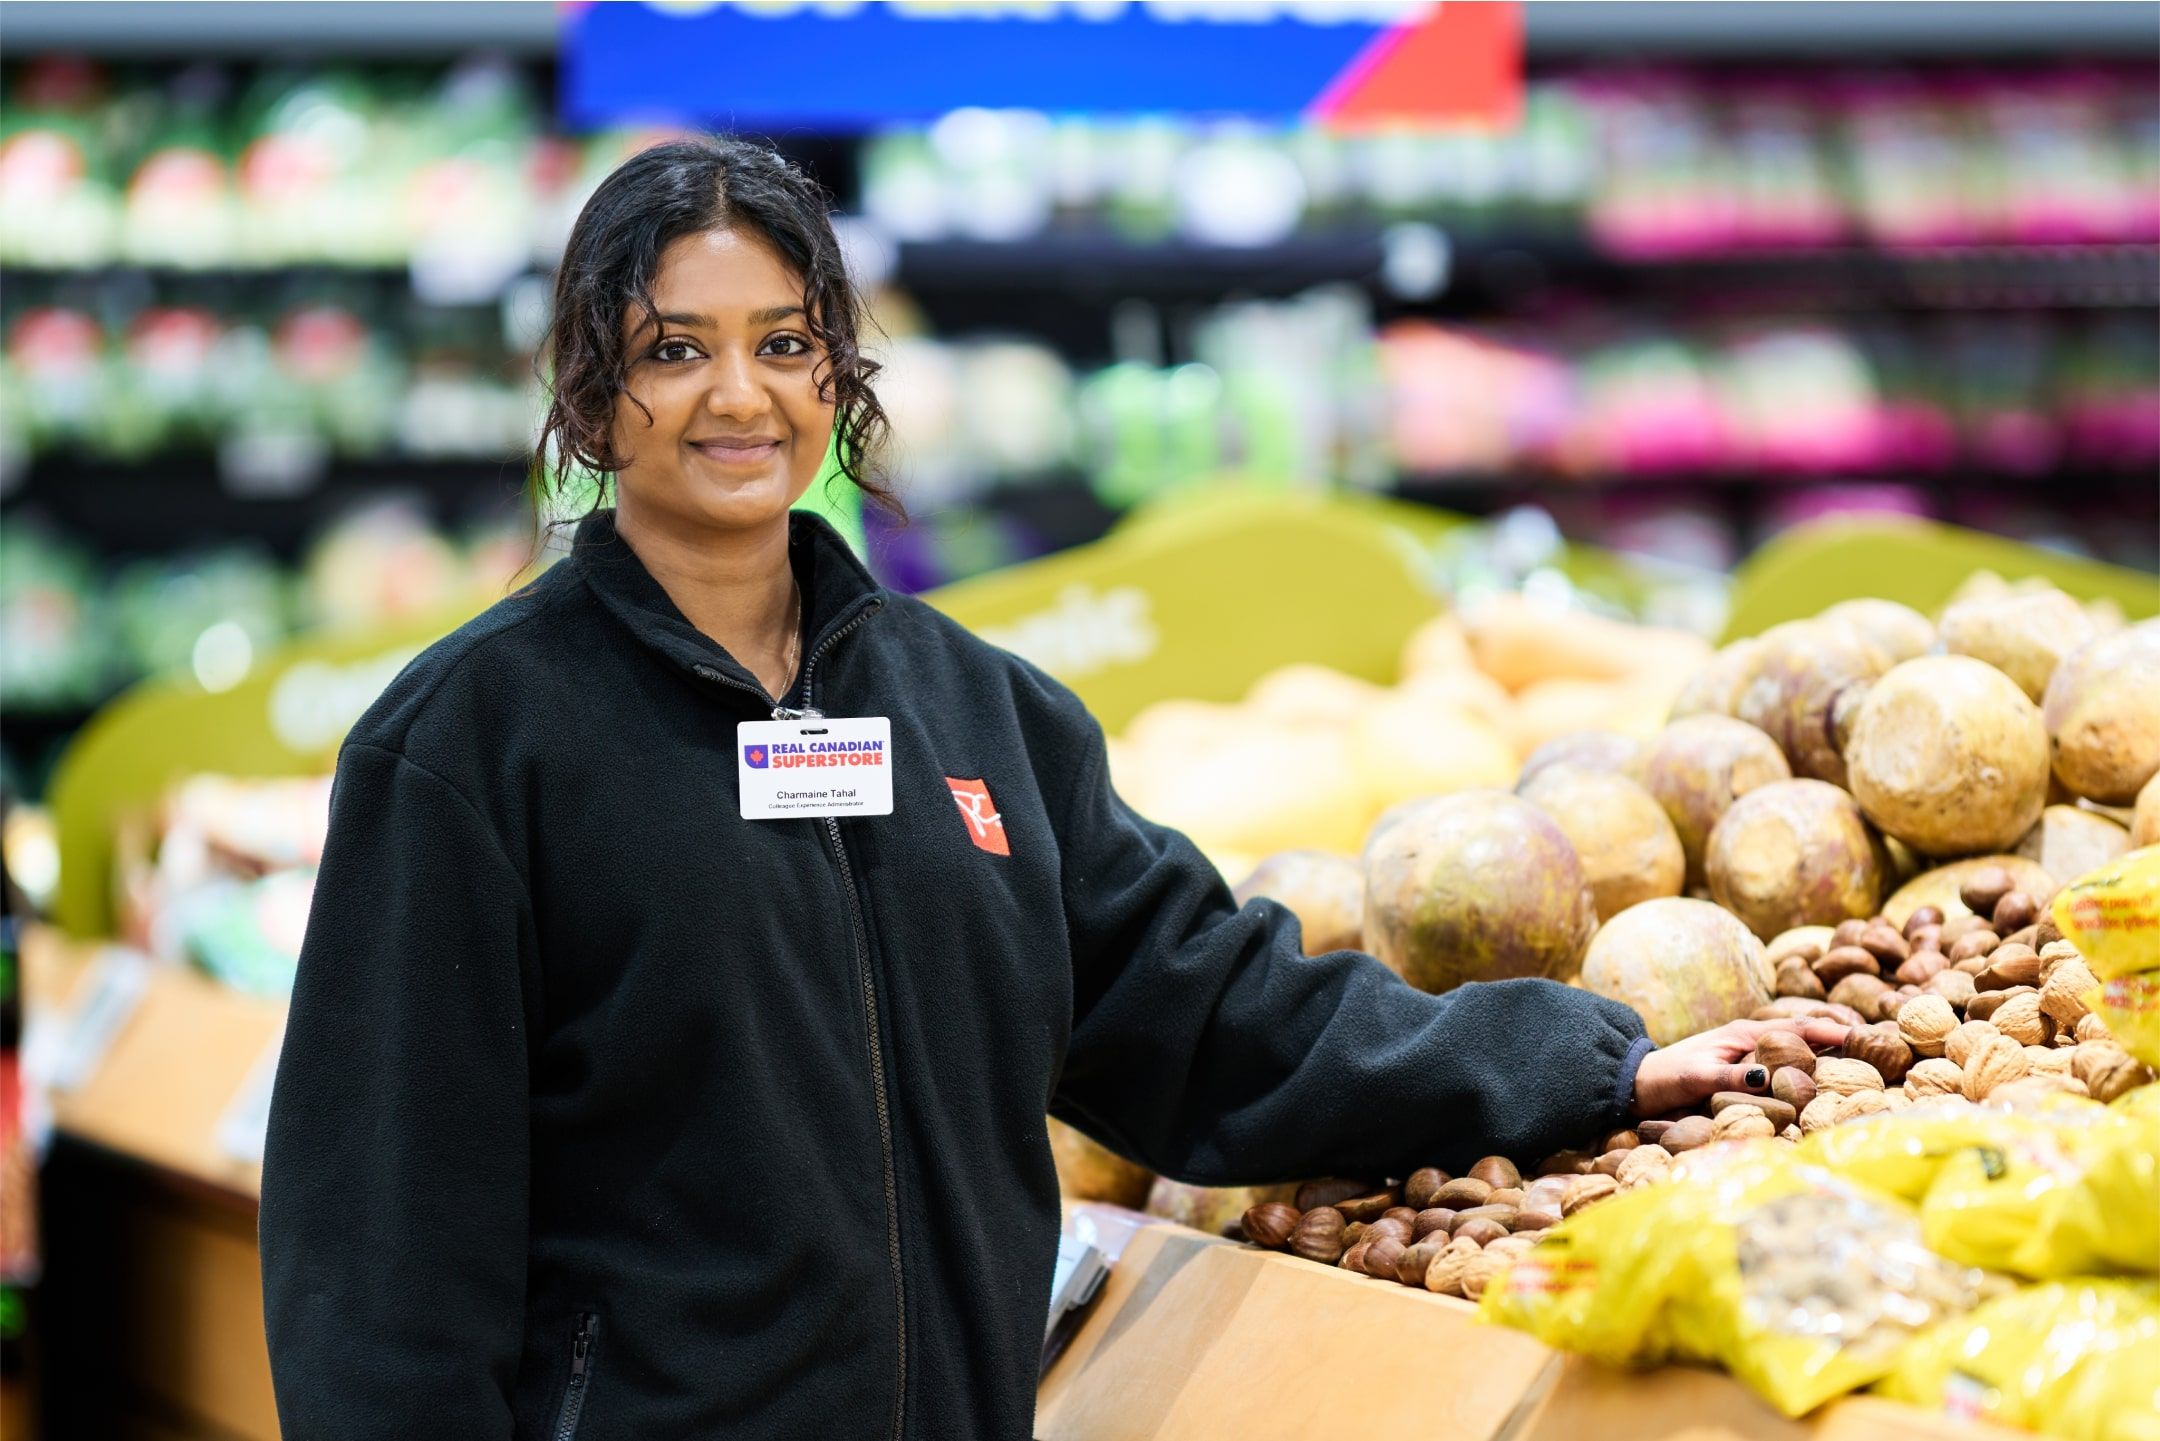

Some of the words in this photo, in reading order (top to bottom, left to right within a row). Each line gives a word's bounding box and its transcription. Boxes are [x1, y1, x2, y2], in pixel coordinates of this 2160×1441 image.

[772, 743, 806, 754] REAL
[809, 740, 883, 753] CANADIAN
[772, 752, 883, 769] SUPERSTORE
[776, 790, 828, 800] Charmaine
[830, 788, 856, 798] Tahal
